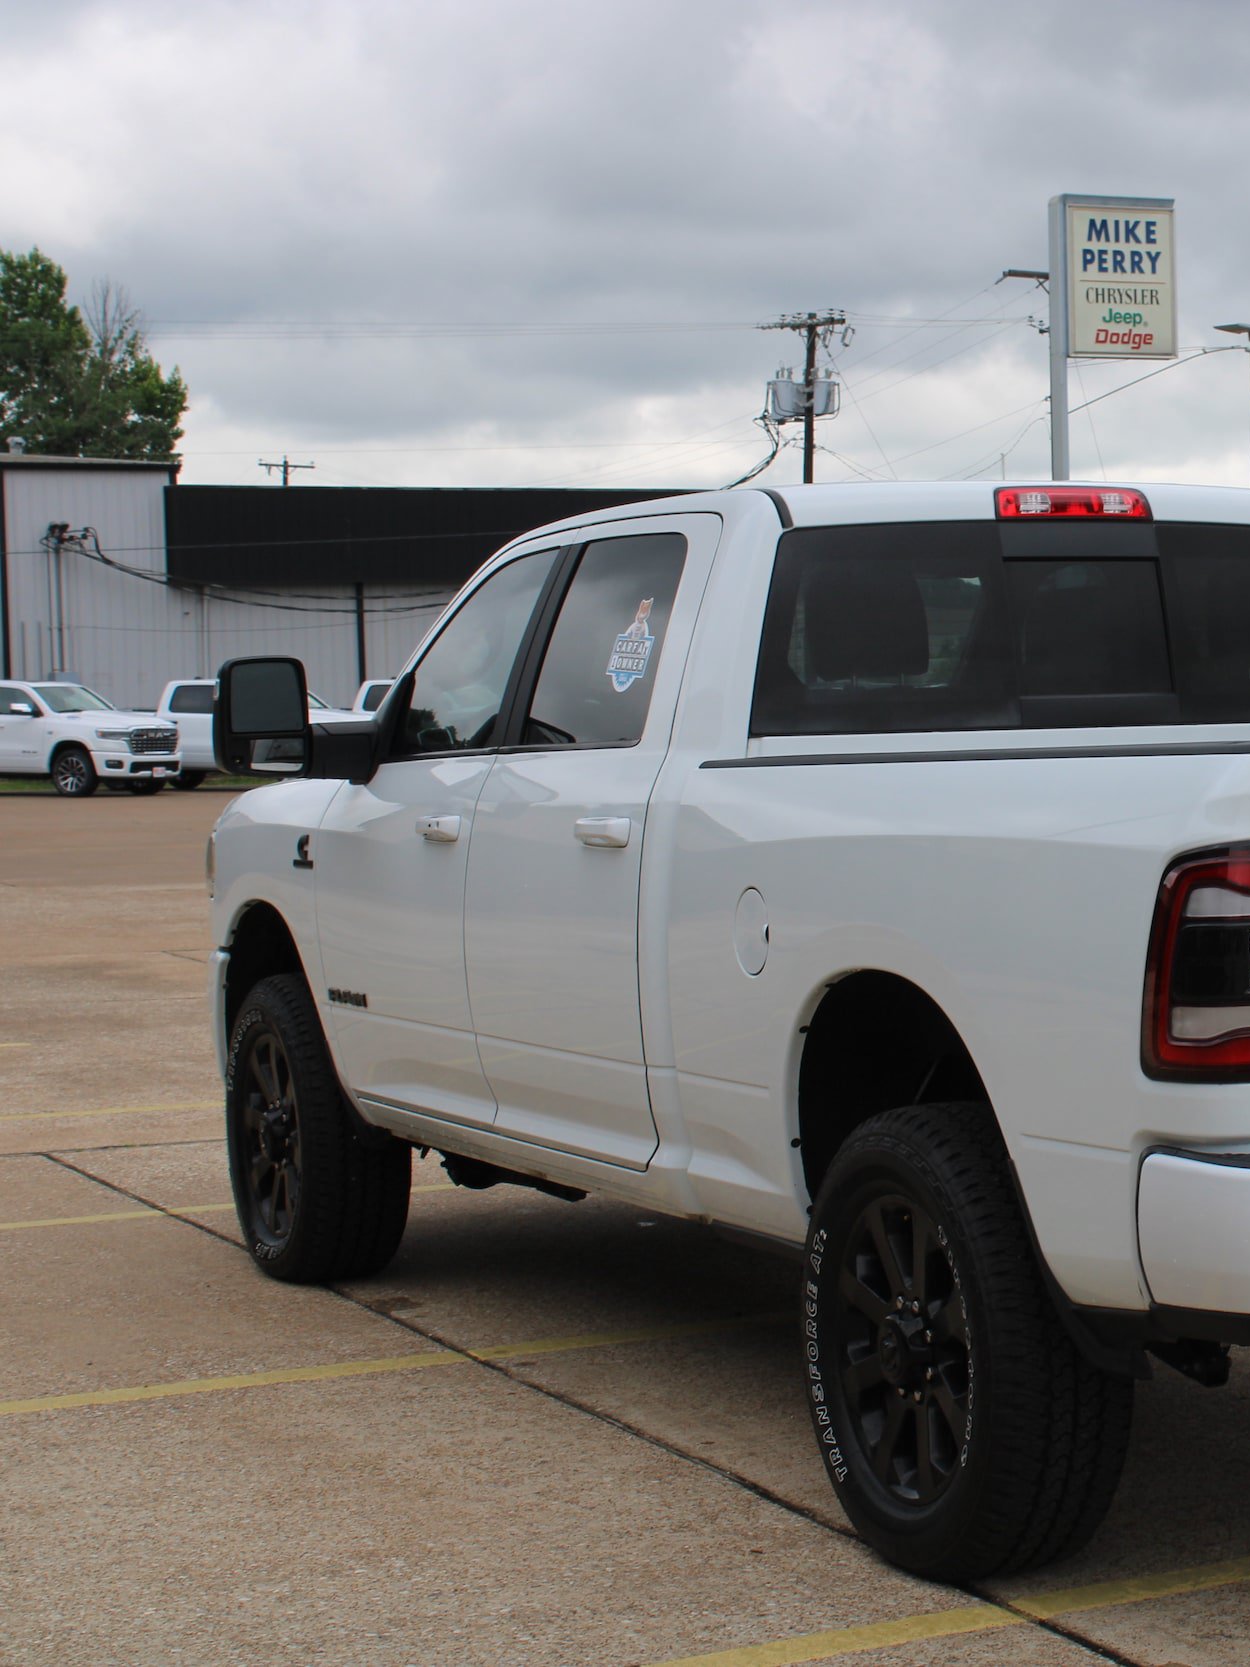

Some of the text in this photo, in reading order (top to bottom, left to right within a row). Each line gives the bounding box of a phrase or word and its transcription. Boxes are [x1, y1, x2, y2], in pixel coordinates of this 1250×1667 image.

[1087, 218, 1157, 245] MIKE
[1081, 248, 1162, 275] PERRY
[1085, 287, 1160, 305] CHRYSLER
[1102, 308, 1143, 327] Jeep
[1095, 328, 1154, 350] Dodge
[805, 1280, 848, 1483] TRANSFORCE
